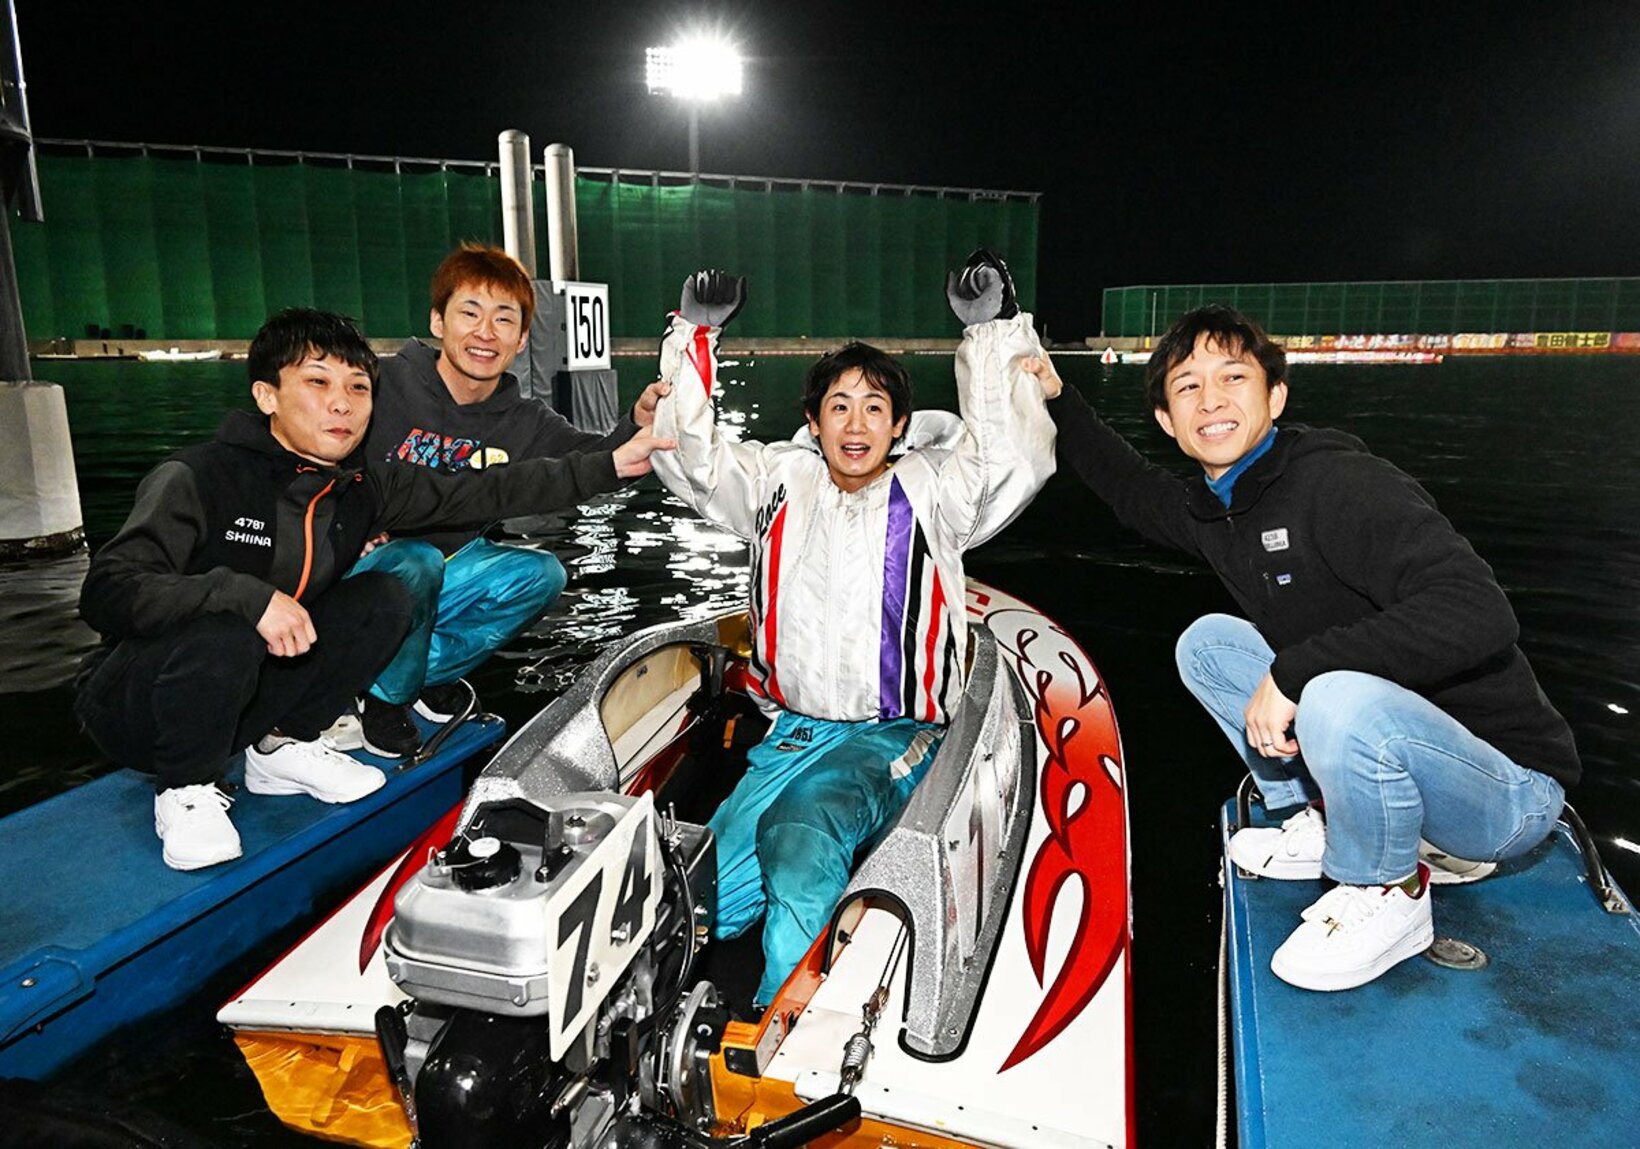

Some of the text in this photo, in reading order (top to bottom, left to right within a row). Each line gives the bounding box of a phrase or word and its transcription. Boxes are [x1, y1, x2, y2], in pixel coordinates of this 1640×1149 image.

[571, 295, 604, 359] 150
[225, 530, 271, 547] SHIINA
[755, 482, 787, 539] Race
[556, 812, 654, 1034] 74
